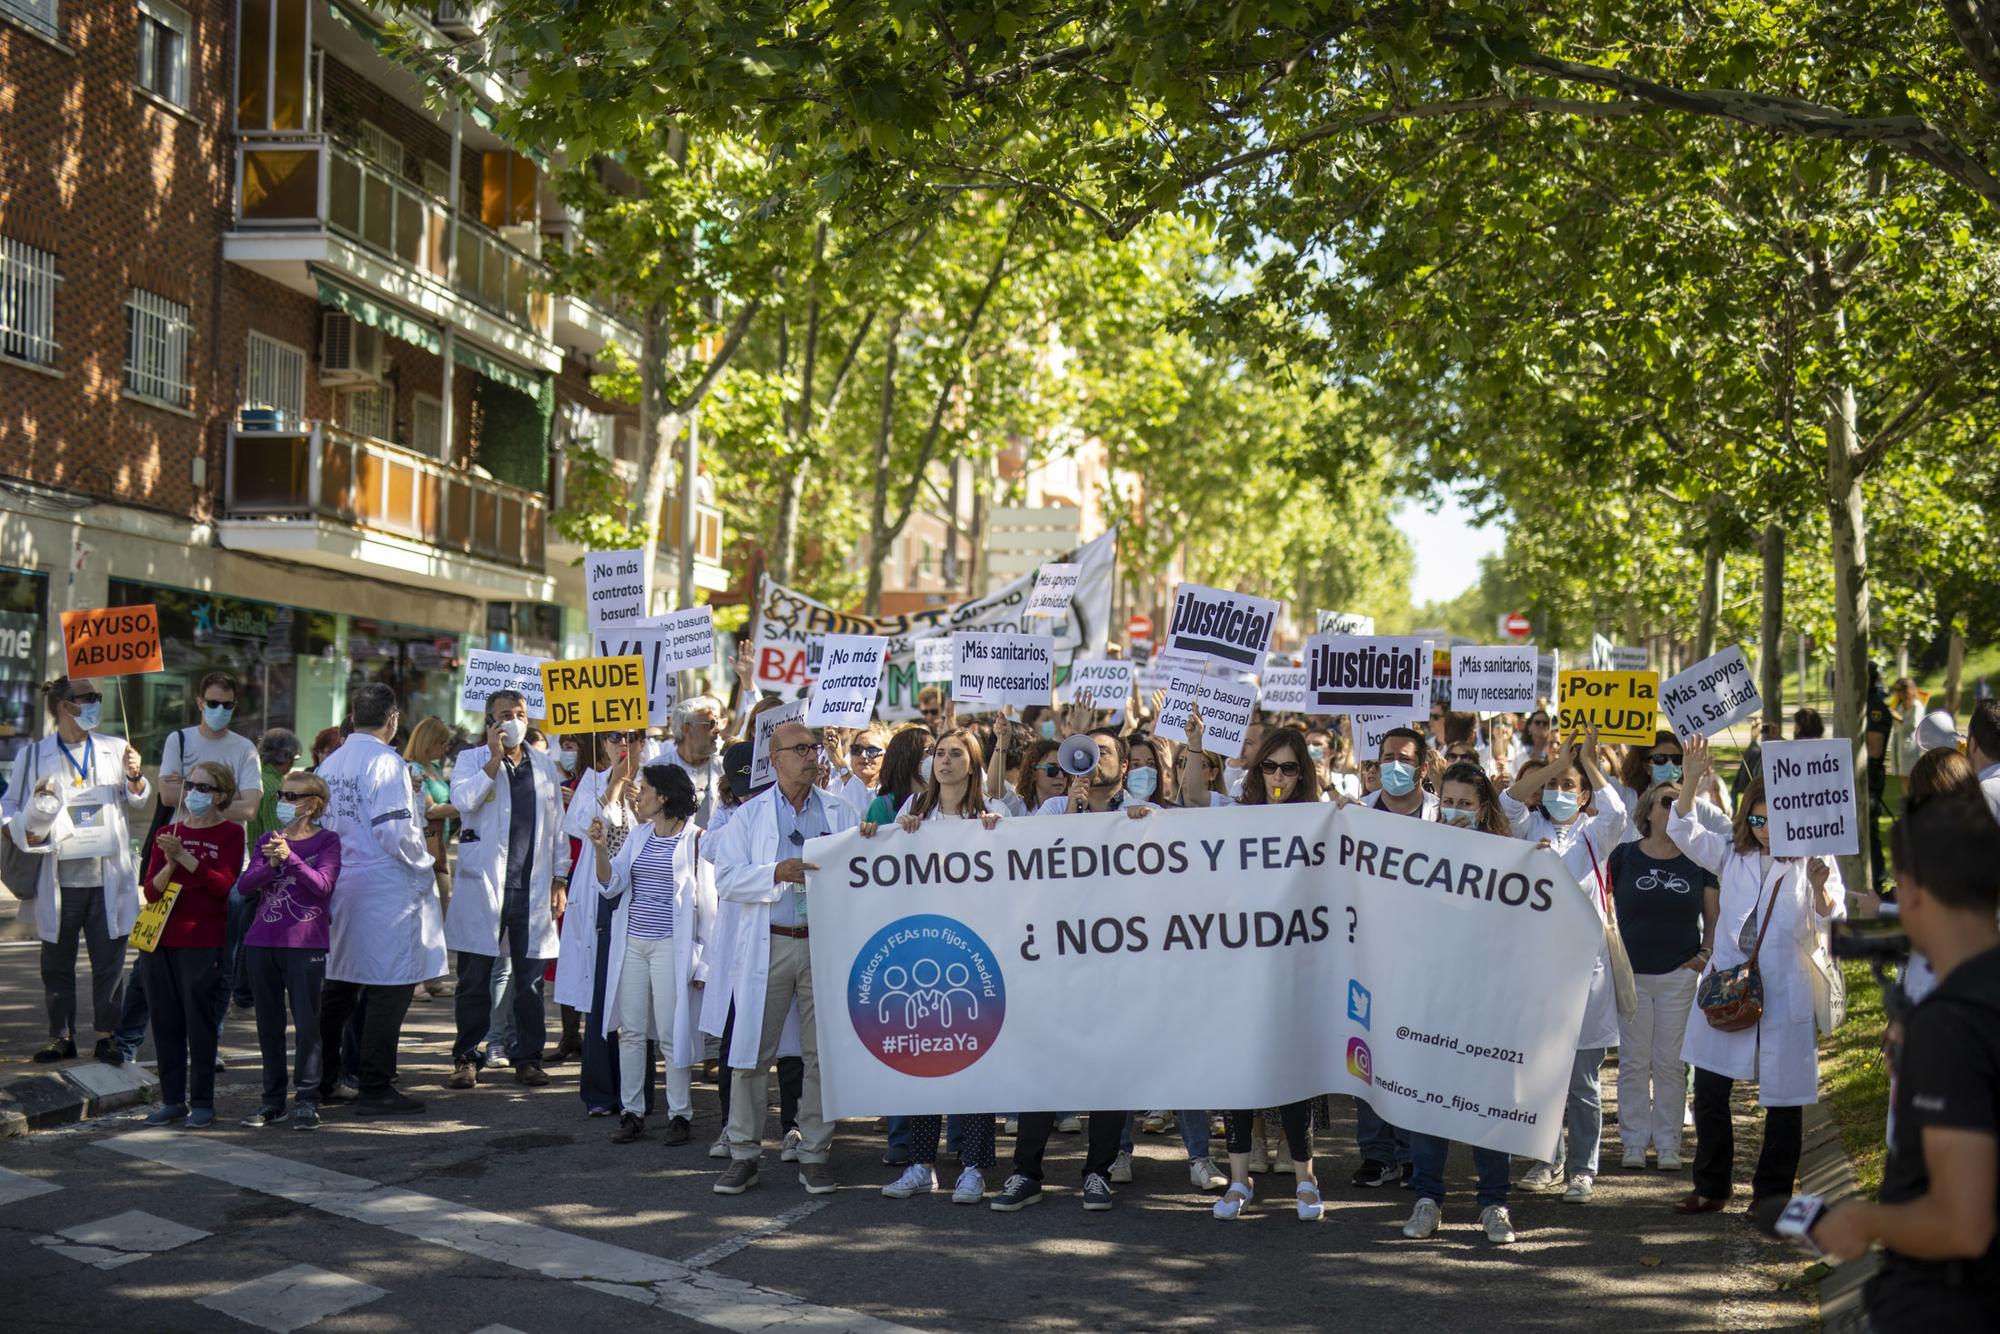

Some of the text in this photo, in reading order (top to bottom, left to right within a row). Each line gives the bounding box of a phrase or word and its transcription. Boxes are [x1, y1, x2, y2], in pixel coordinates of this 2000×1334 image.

[593, 560, 638, 583] ¡No más
[592, 584, 644, 601] contratos
[601, 603, 639, 622] basura!
[677, 615, 710, 630] basura
[1171, 592, 1274, 652] ¡Justicia!
[71, 614, 155, 644] ¡AYUSO,
[673, 627, 713, 647] personal
[74, 640, 156, 666] ABUSO!
[674, 650, 683, 661] tu
[686, 643, 713, 659] salud.
[828, 649, 849, 670] ¡No
[852, 647, 878, 664] más
[962, 640, 1049, 665] ¡Más sanitarios,
[470, 657, 542, 676] Empleo basu
[547, 664, 639, 691] FRAUDE
[1074, 666, 1130, 682] ¡AYUSO,
[1310, 644, 1421, 691] ¡Justicia!
[1460, 656, 1482, 677] ¡Más
[1484, 656, 1533, 675] sanitarios,
[465, 675, 472, 686] y
[475, 675, 501, 687] poco
[822, 674, 878, 691] contratos
[960, 673, 985, 693] muy
[987, 672, 1049, 691] necesarios!
[1170, 678, 1251, 708] Empleo basura
[1457, 682, 1534, 704] muy necesarios!
[1560, 676, 1619, 703] ¡Por
[1629, 678, 1655, 699] la
[1664, 658, 1745, 716] ¡Más apoyos
[464, 689, 545, 708] daña lud.
[822, 697, 868, 713] basura!
[1678, 680, 1758, 737] a la Sanidad!
[552, 702, 580, 725] DE
[592, 697, 641, 723] LEY!
[1163, 697, 1250, 726] y poc personal
[1560, 708, 1653, 731] SALUD!
[1161, 712, 1242, 743] daña salud.
[756, 757, 769, 774] muy
[1773, 753, 1840, 785] ¡No más
[1773, 789, 1849, 811] contratos
[1787, 815, 1845, 841] basura!
[849, 834, 1554, 912] SOMOS MÉDICOS Y FEAs PRECARIOS
[1020, 905, 1358, 961] ¿ NOS AYUDAS ?
[859, 952, 883, 1005] Médicos
[880, 944, 890, 957] y
[888, 929, 920, 949] FEAs
[922, 928, 939, 938] no
[941, 928, 968, 951] fijos
[970, 953, 996, 998] Madrid
[882, 1033, 978, 1056] #FijezaYa
[1396, 1026, 1525, 1064] @madrid_ope2021
[1374, 1075, 1538, 1125] medicos_no_fijos_madrid
